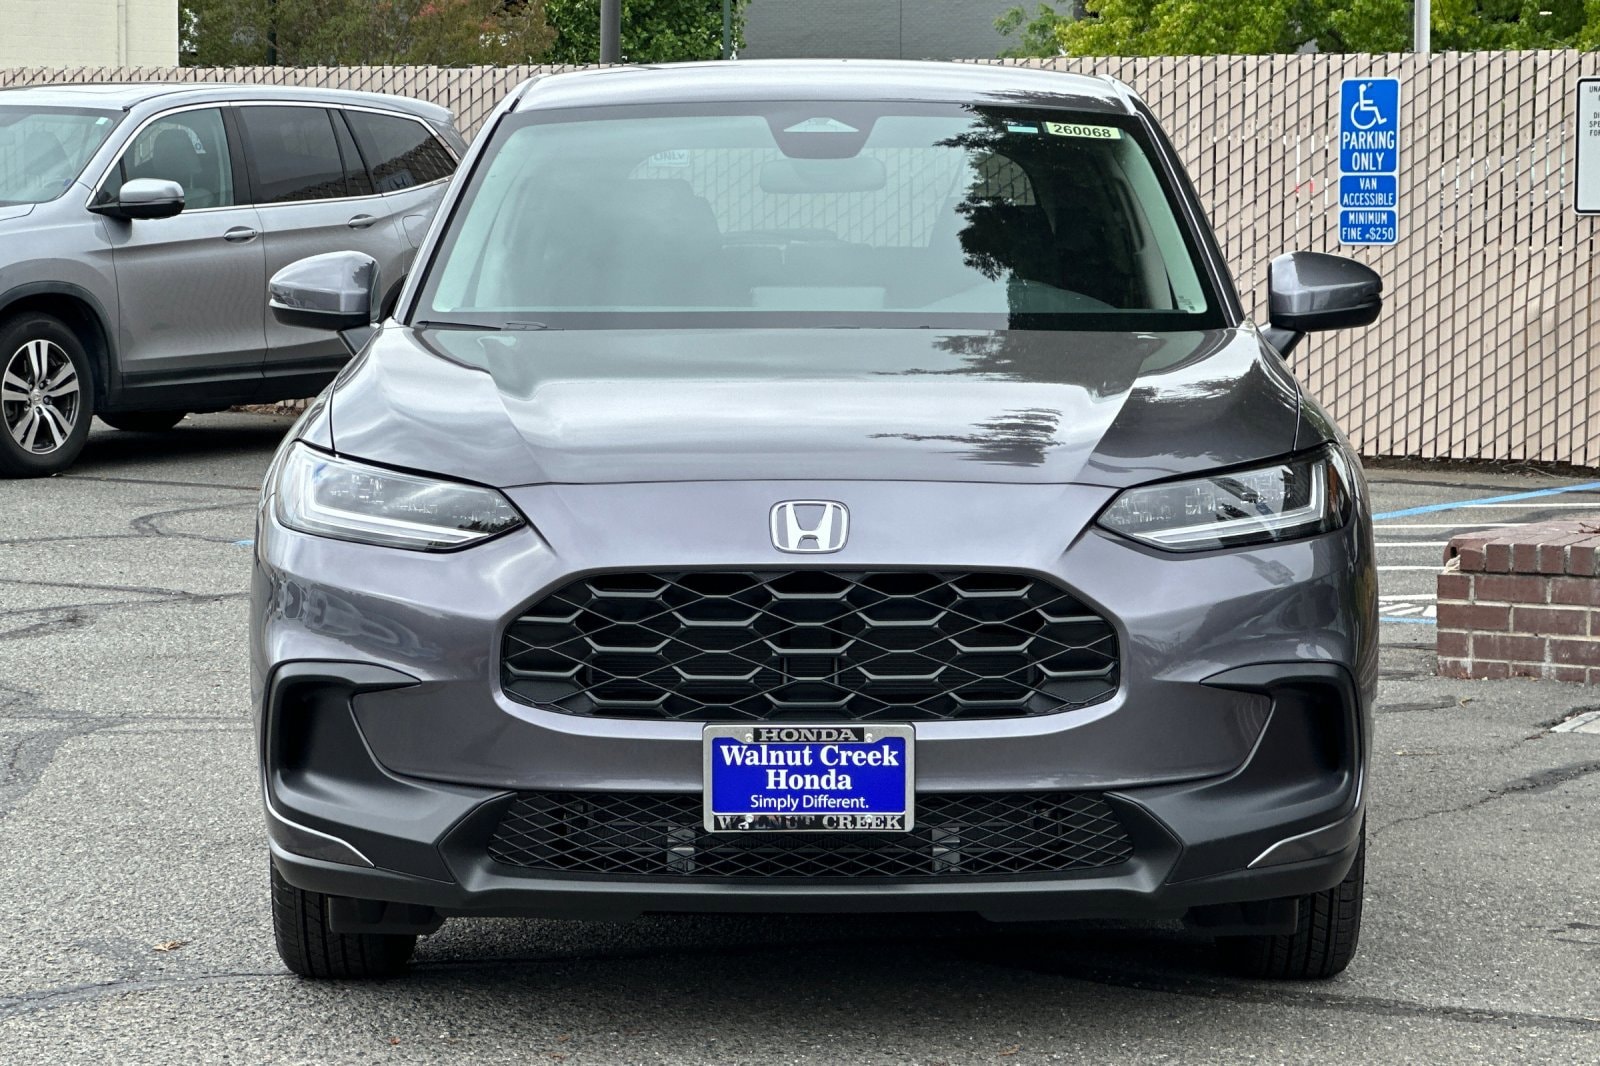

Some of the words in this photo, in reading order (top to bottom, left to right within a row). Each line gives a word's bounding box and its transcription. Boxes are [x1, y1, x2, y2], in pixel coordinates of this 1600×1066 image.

[1053, 124, 1111, 138] 260068
[1342, 131, 1395, 150] PARKING
[1351, 151, 1385, 171] ONLY
[1359, 177, 1378, 190] VAN
[1342, 193, 1394, 206] ACCESSIBLE
[1348, 212, 1388, 225] MINIMUM
[1342, 227, 1362, 240] FINE
[758, 728, 858, 742] HONDA
[720, 745, 813, 766] Walnut
[820, 745, 899, 766] Creek
[766, 769, 852, 790] Honda
[750, 794, 799, 811] Simply
[803, 794, 869, 809] Different.
[716, 815, 815, 830] WLNUT
[822, 815, 902, 831] CREEK
